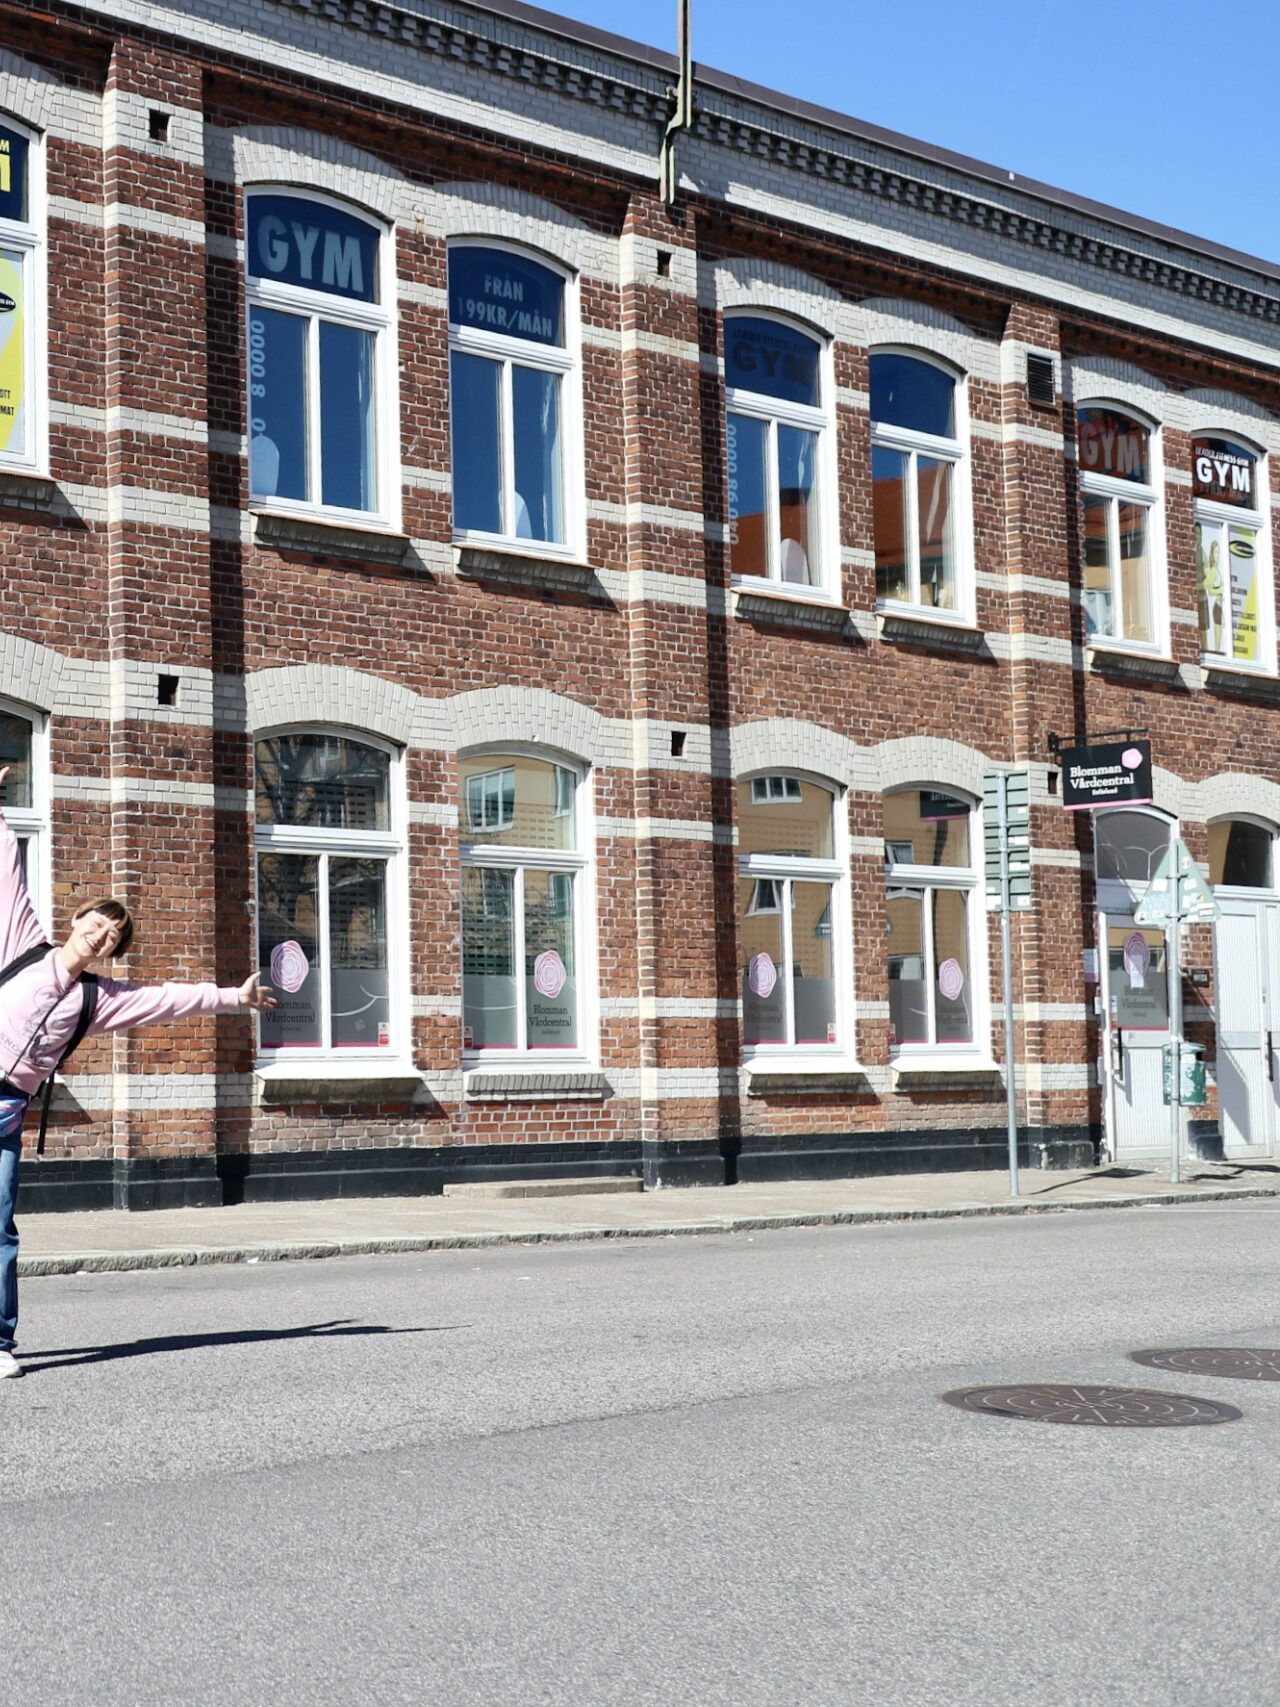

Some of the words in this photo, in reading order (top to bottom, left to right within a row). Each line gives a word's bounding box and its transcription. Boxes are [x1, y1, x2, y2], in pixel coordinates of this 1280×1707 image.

[257, 215, 364, 293] GYM
[484, 272, 523, 302] FRÅN
[0, 405, 15, 417] MAT
[1080, 423, 1141, 477] GYM
[1196, 457, 1250, 493] GYM
[1069, 765, 1122, 778] Blomman
[1070, 772, 1134, 789] Vårdcentral
[533, 1004, 568, 1015] Blomman
[266, 1011, 315, 1024] Vårdcentral
[529, 1016, 571, 1027] Vårdcentral
